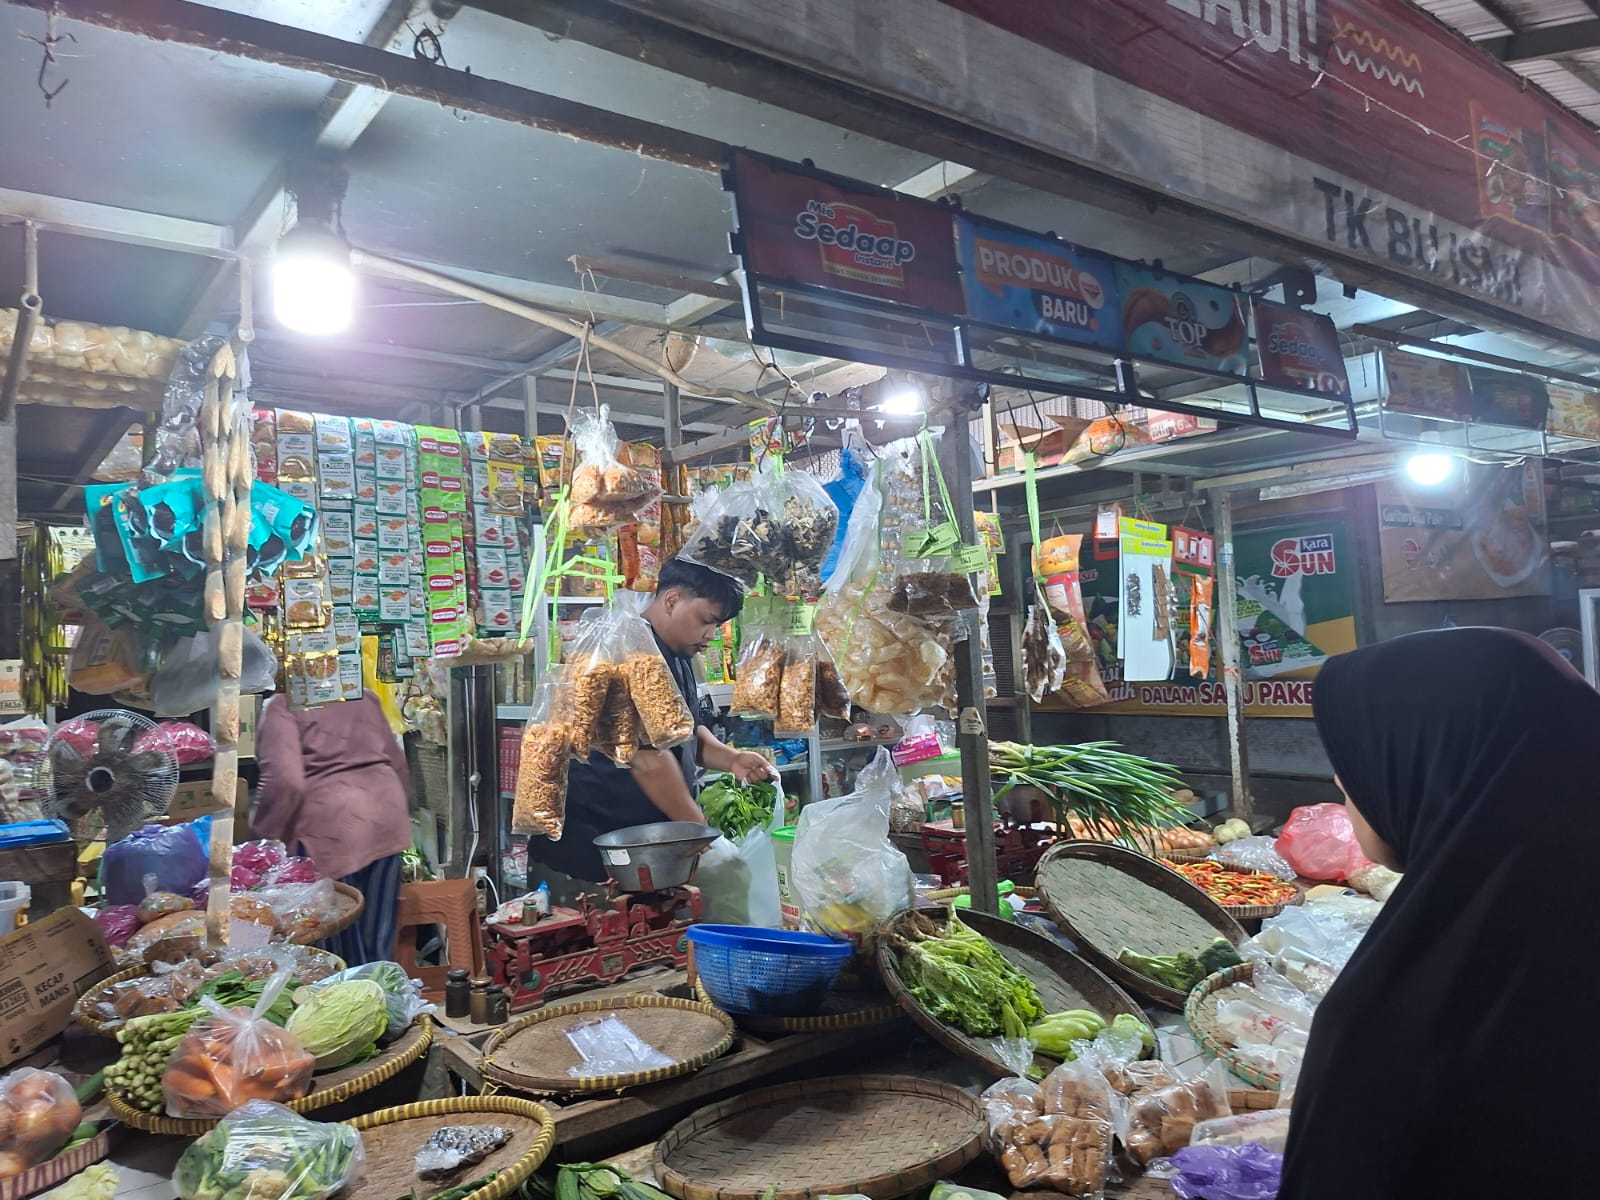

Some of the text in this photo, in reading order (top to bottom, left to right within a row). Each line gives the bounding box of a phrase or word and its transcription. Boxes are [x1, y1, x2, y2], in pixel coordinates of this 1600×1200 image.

[807, 200, 836, 219] Mie
[1313, 177, 1374, 254] TK
[795, 212, 915, 265] Sedaap
[979, 246, 1078, 291] PRODUK
[1041, 295, 1089, 326] BARU
[1163, 316, 1208, 346] TOP
[1271, 539, 1335, 577] SUN
[1302, 538, 1329, 551] kara
[1142, 686, 1196, 704] DALAM
[1199, 681, 1255, 705] SAU
[1259, 681, 1314, 705] PAKE
[34, 972, 65, 995] KECAP
[39, 983, 70, 1008] MANIS
